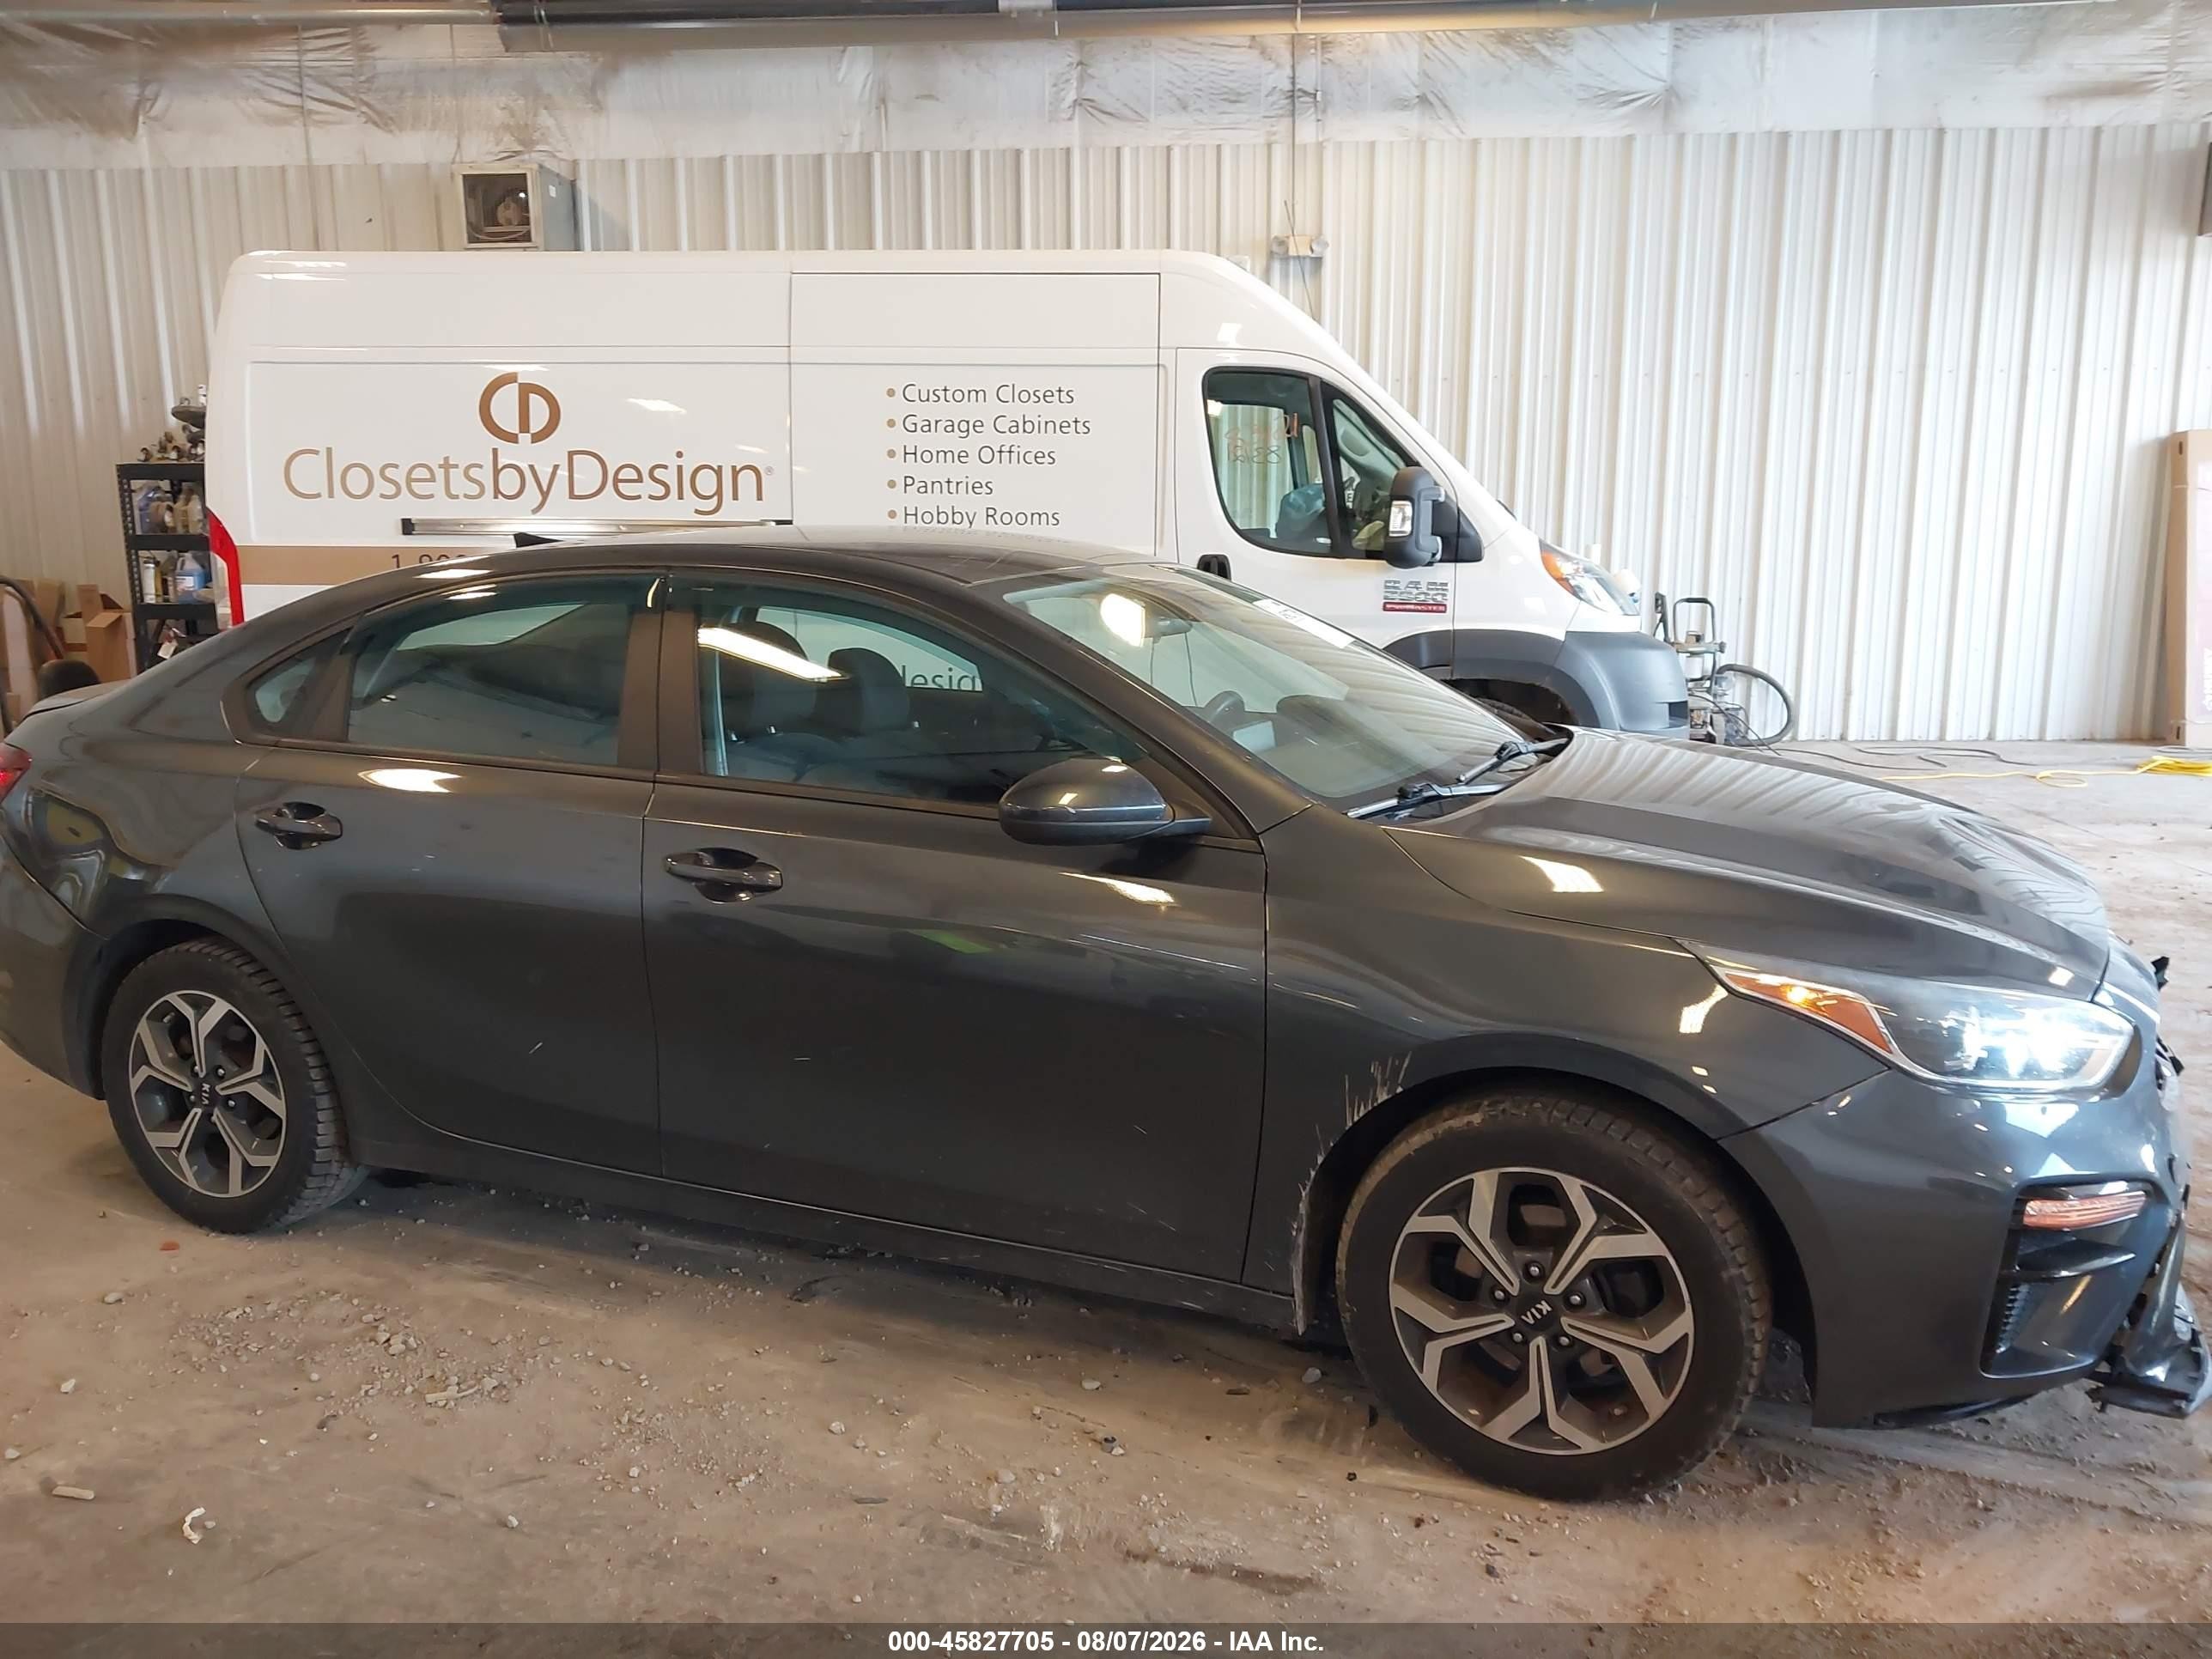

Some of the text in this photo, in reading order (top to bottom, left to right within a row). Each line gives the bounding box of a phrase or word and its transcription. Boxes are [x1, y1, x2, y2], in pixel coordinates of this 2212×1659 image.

[902, 383, 1075, 404] Custom Closets
[902, 414, 1091, 439] Garage Cabinets
[902, 444, 1056, 465] Home Offices
[902, 475, 994, 495] Pantries
[903, 505, 1060, 529] Hobby Rooms
[1383, 580, 1449, 592] RAM
[201, 1083, 210, 1105] KIA
[1521, 1300, 1553, 1325] KIA
